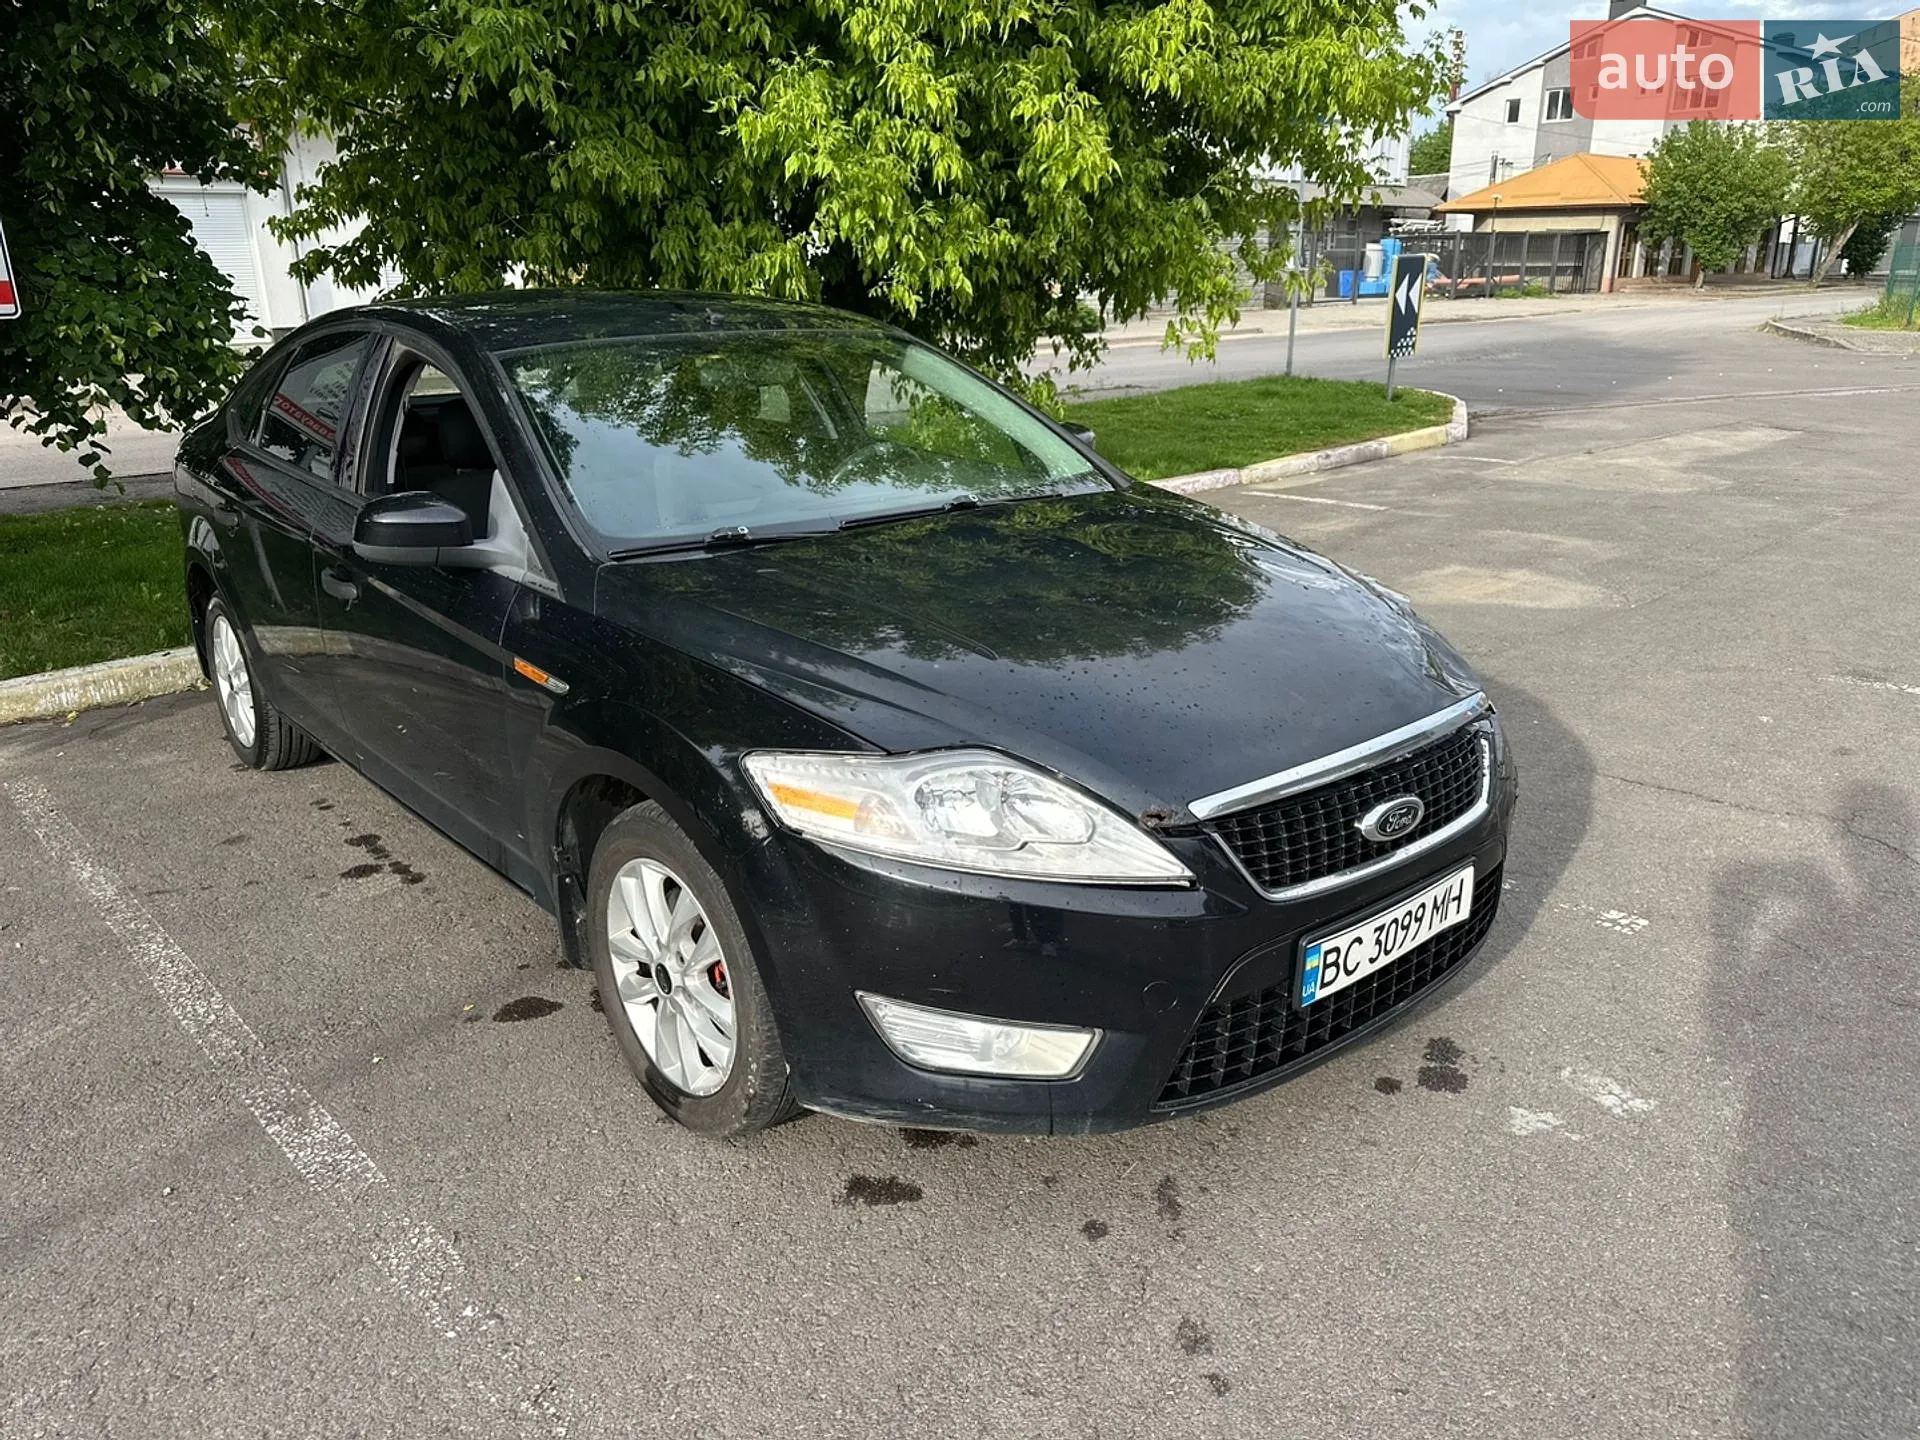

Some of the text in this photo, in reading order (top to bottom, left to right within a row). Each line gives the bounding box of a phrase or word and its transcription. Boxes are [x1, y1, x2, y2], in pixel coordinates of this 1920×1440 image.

[1386, 807, 1416, 833] Ford
[1319, 878, 1464, 991] BC 3099 MH
[1302, 981, 1315, 997] UA
